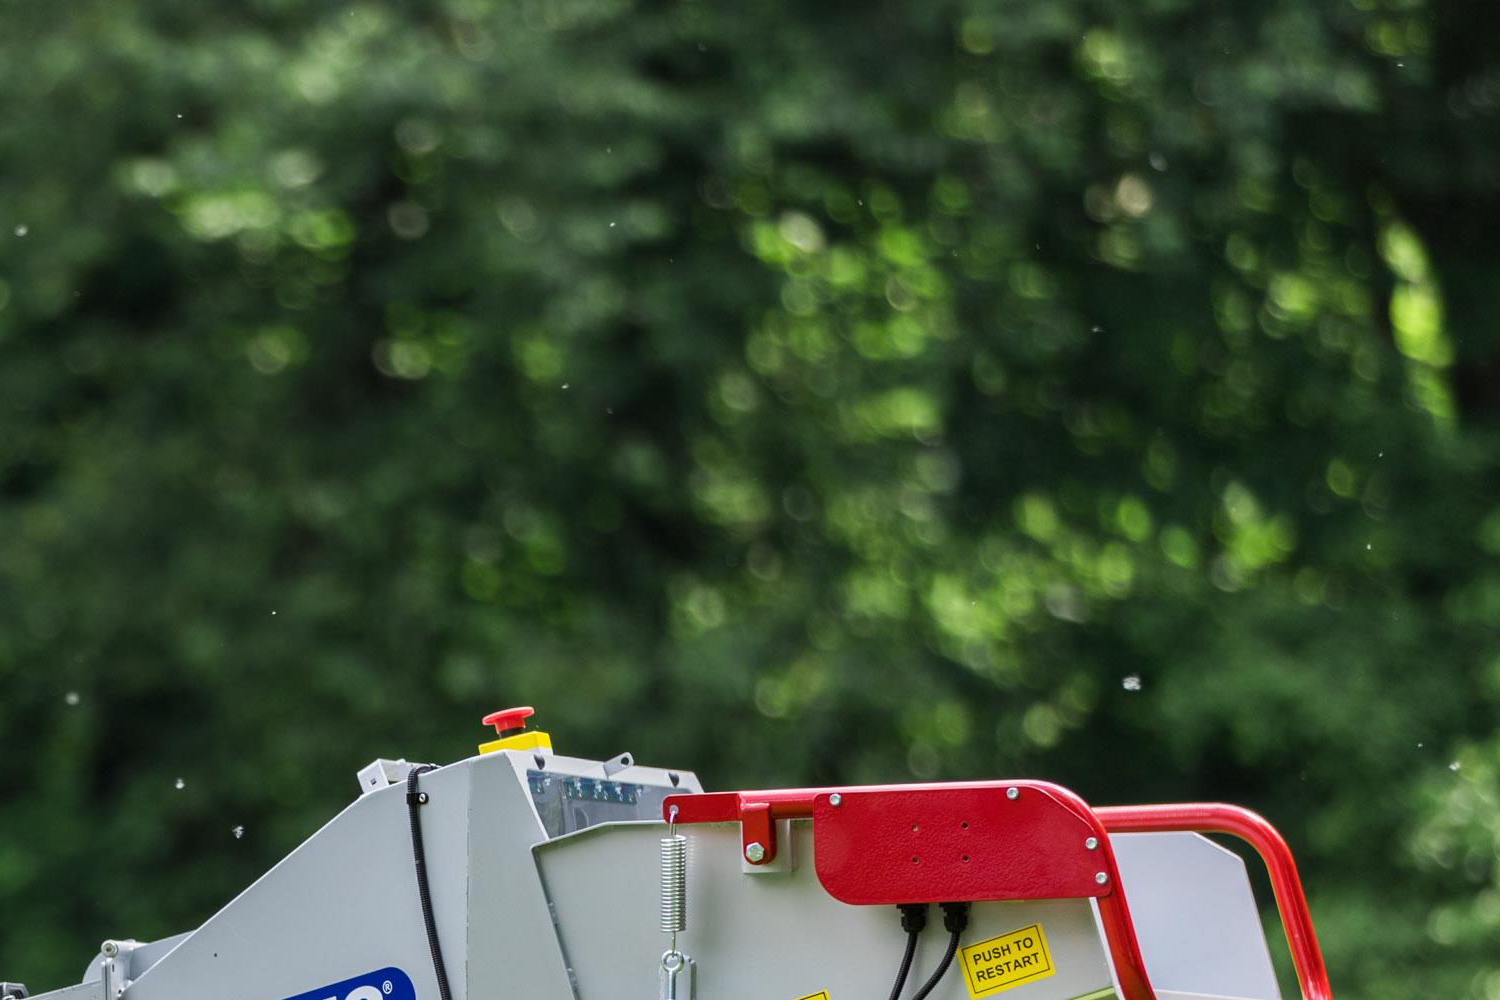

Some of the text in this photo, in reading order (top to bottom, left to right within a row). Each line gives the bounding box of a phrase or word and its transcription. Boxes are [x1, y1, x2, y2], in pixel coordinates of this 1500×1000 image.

[973, 937, 1034, 965] PUSH TO
[976, 952, 1040, 982] RESTART
